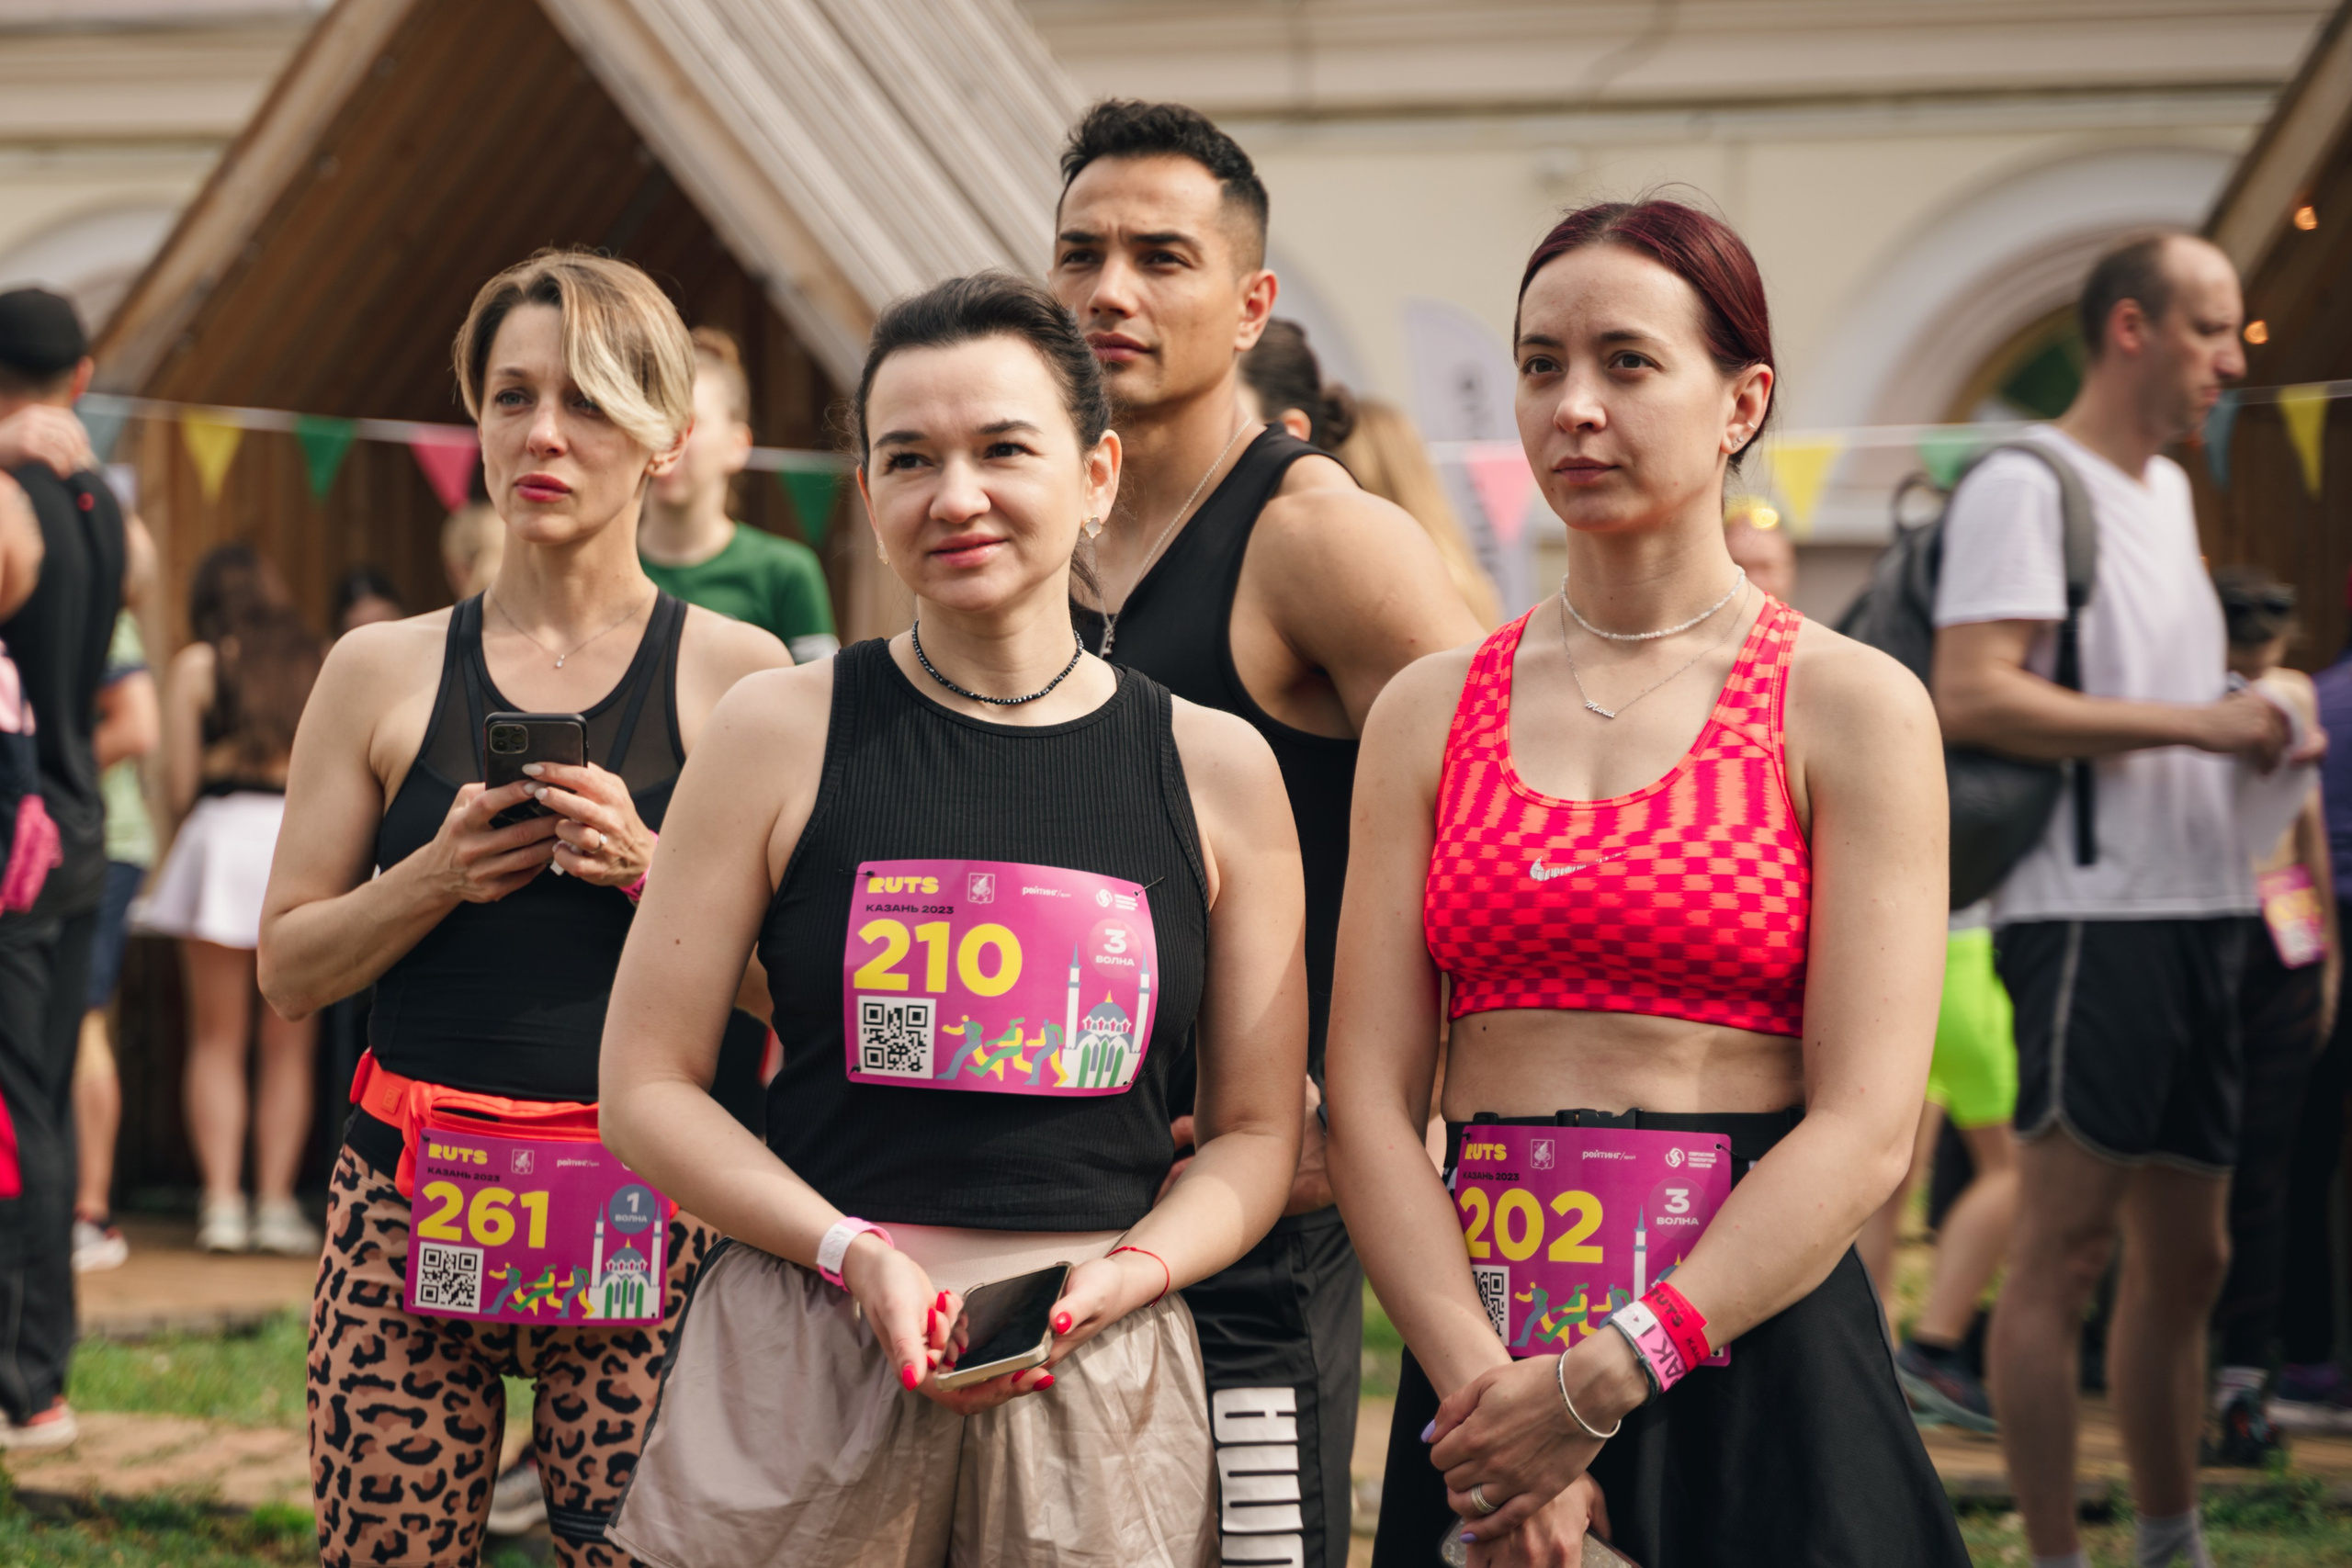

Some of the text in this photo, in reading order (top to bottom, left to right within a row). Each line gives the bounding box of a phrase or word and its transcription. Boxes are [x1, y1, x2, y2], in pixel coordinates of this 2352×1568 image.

[866, 875, 940, 895] RUTS
[865, 904, 955, 915] КАЗАНЬ 2023
[1102, 928, 1127, 954] 3
[854, 918, 1023, 998] 210
[1095, 954, 1135, 967] ВОЛНА
[428, 1144, 488, 1165] RUTS
[1464, 1143, 1508, 1161] RUTS
[427, 1167, 501, 1183] КАЗАНЬ 2023
[1463, 1171, 1520, 1182] КАЗАНЬ 2023
[627, 1192, 640, 1213] 1
[1664, 1189, 1690, 1214] 3
[417, 1180, 549, 1249] 261
[615, 1213, 649, 1224] ВОЛНА
[1657, 1216, 1700, 1226] ВОЛНА
[1458, 1186, 1604, 1264] 202
[1649, 1289, 1685, 1328] RUTS
